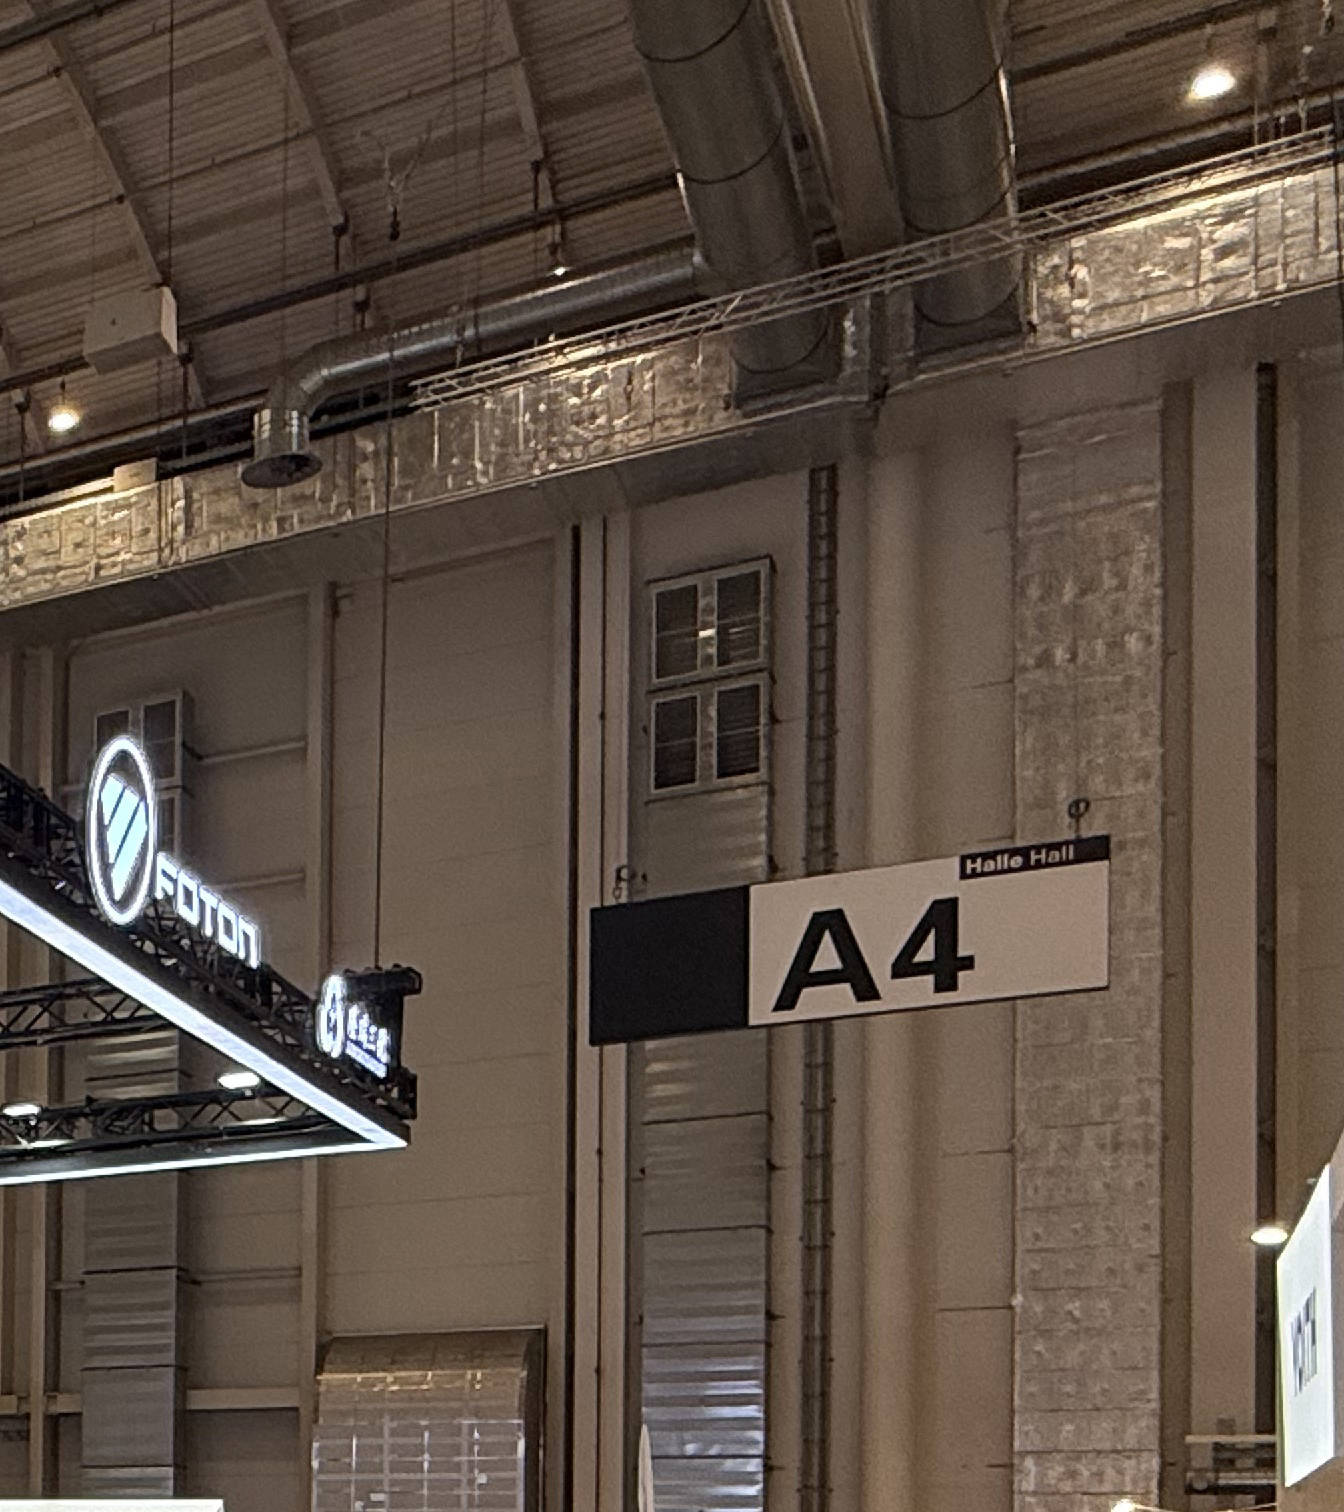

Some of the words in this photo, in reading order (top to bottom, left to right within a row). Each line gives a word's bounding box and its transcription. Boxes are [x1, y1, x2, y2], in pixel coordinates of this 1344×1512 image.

[154, 851, 261, 970] FOTON
[966, 853, 1023, 874] Halle
[1030, 844, 1074, 866] Hall
[771, 897, 976, 1012] A4
